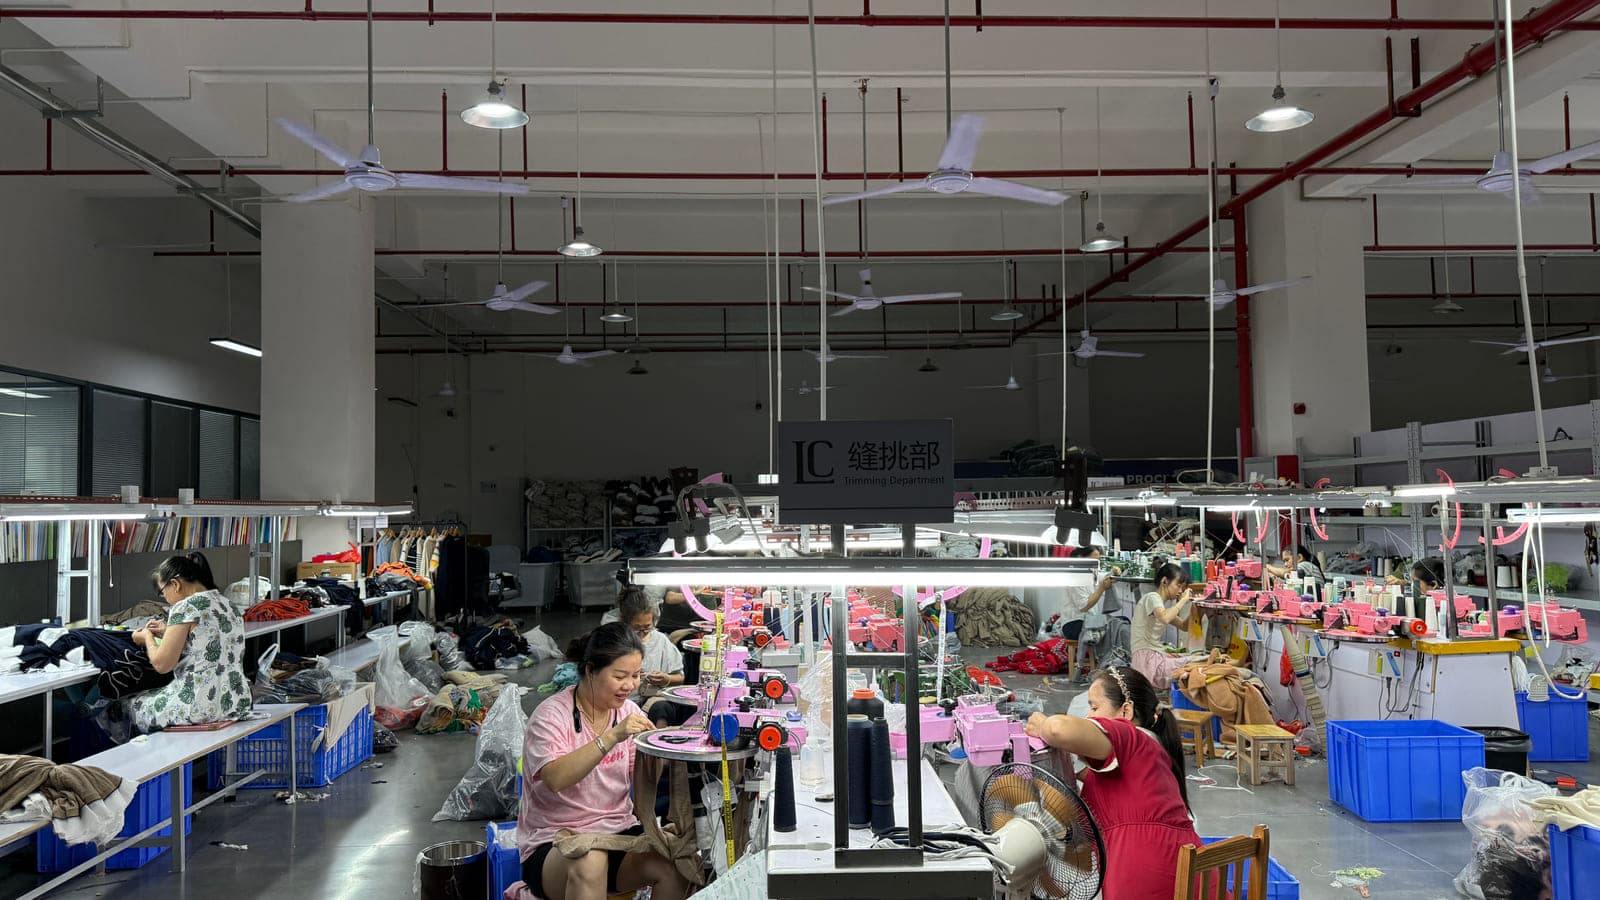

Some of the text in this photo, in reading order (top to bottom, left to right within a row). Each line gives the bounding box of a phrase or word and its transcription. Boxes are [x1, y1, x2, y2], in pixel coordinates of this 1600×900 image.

[792, 440, 835, 485] LC
[848, 440, 940, 471] 缝挑部
[844, 475, 945, 487] Trimming Department
